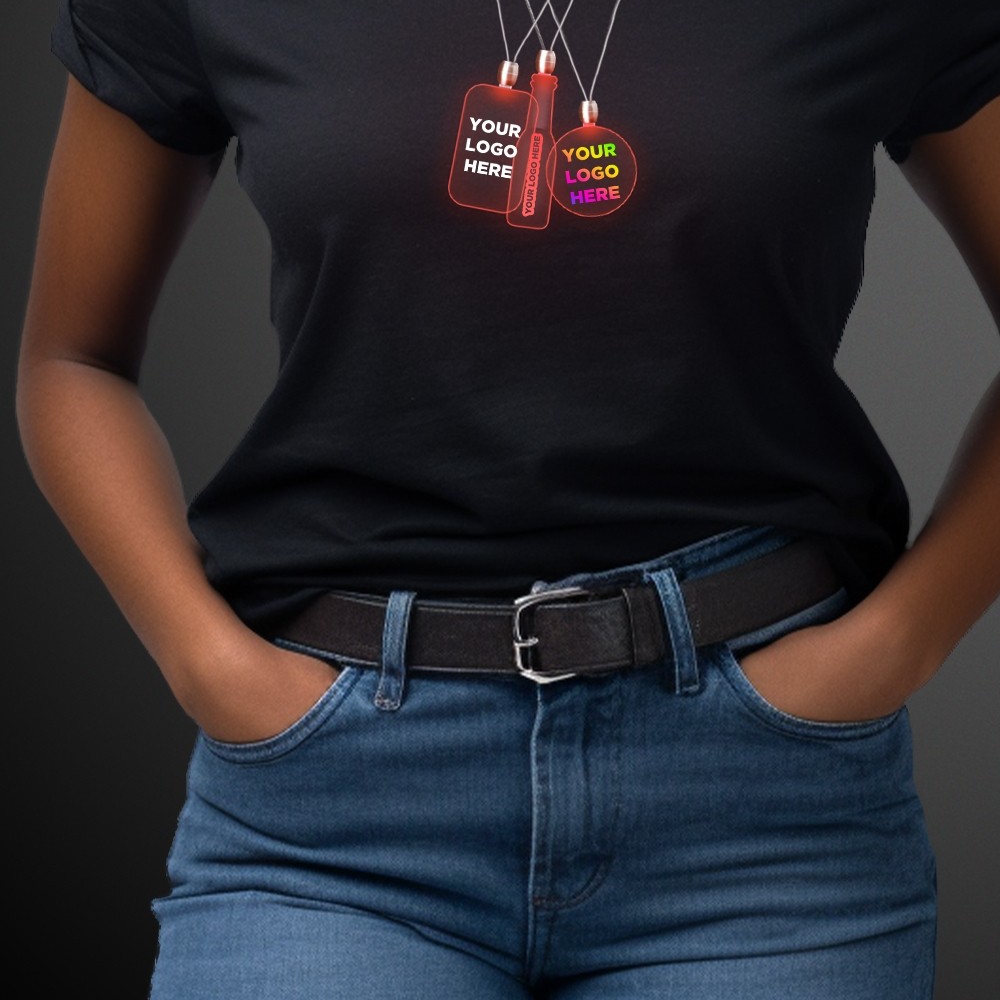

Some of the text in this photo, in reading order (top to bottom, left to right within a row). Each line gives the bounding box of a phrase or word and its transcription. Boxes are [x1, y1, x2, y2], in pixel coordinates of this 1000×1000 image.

[469, 116, 521, 139] YOUR
[465, 137, 518, 159] LOGO
[562, 143, 617, 163] YOUR
[464, 158, 513, 179] HERE
[524, 135, 541, 215] YOUR LOGO HERE
[565, 164, 620, 184] LOGO
[570, 185, 621, 205] HERE
